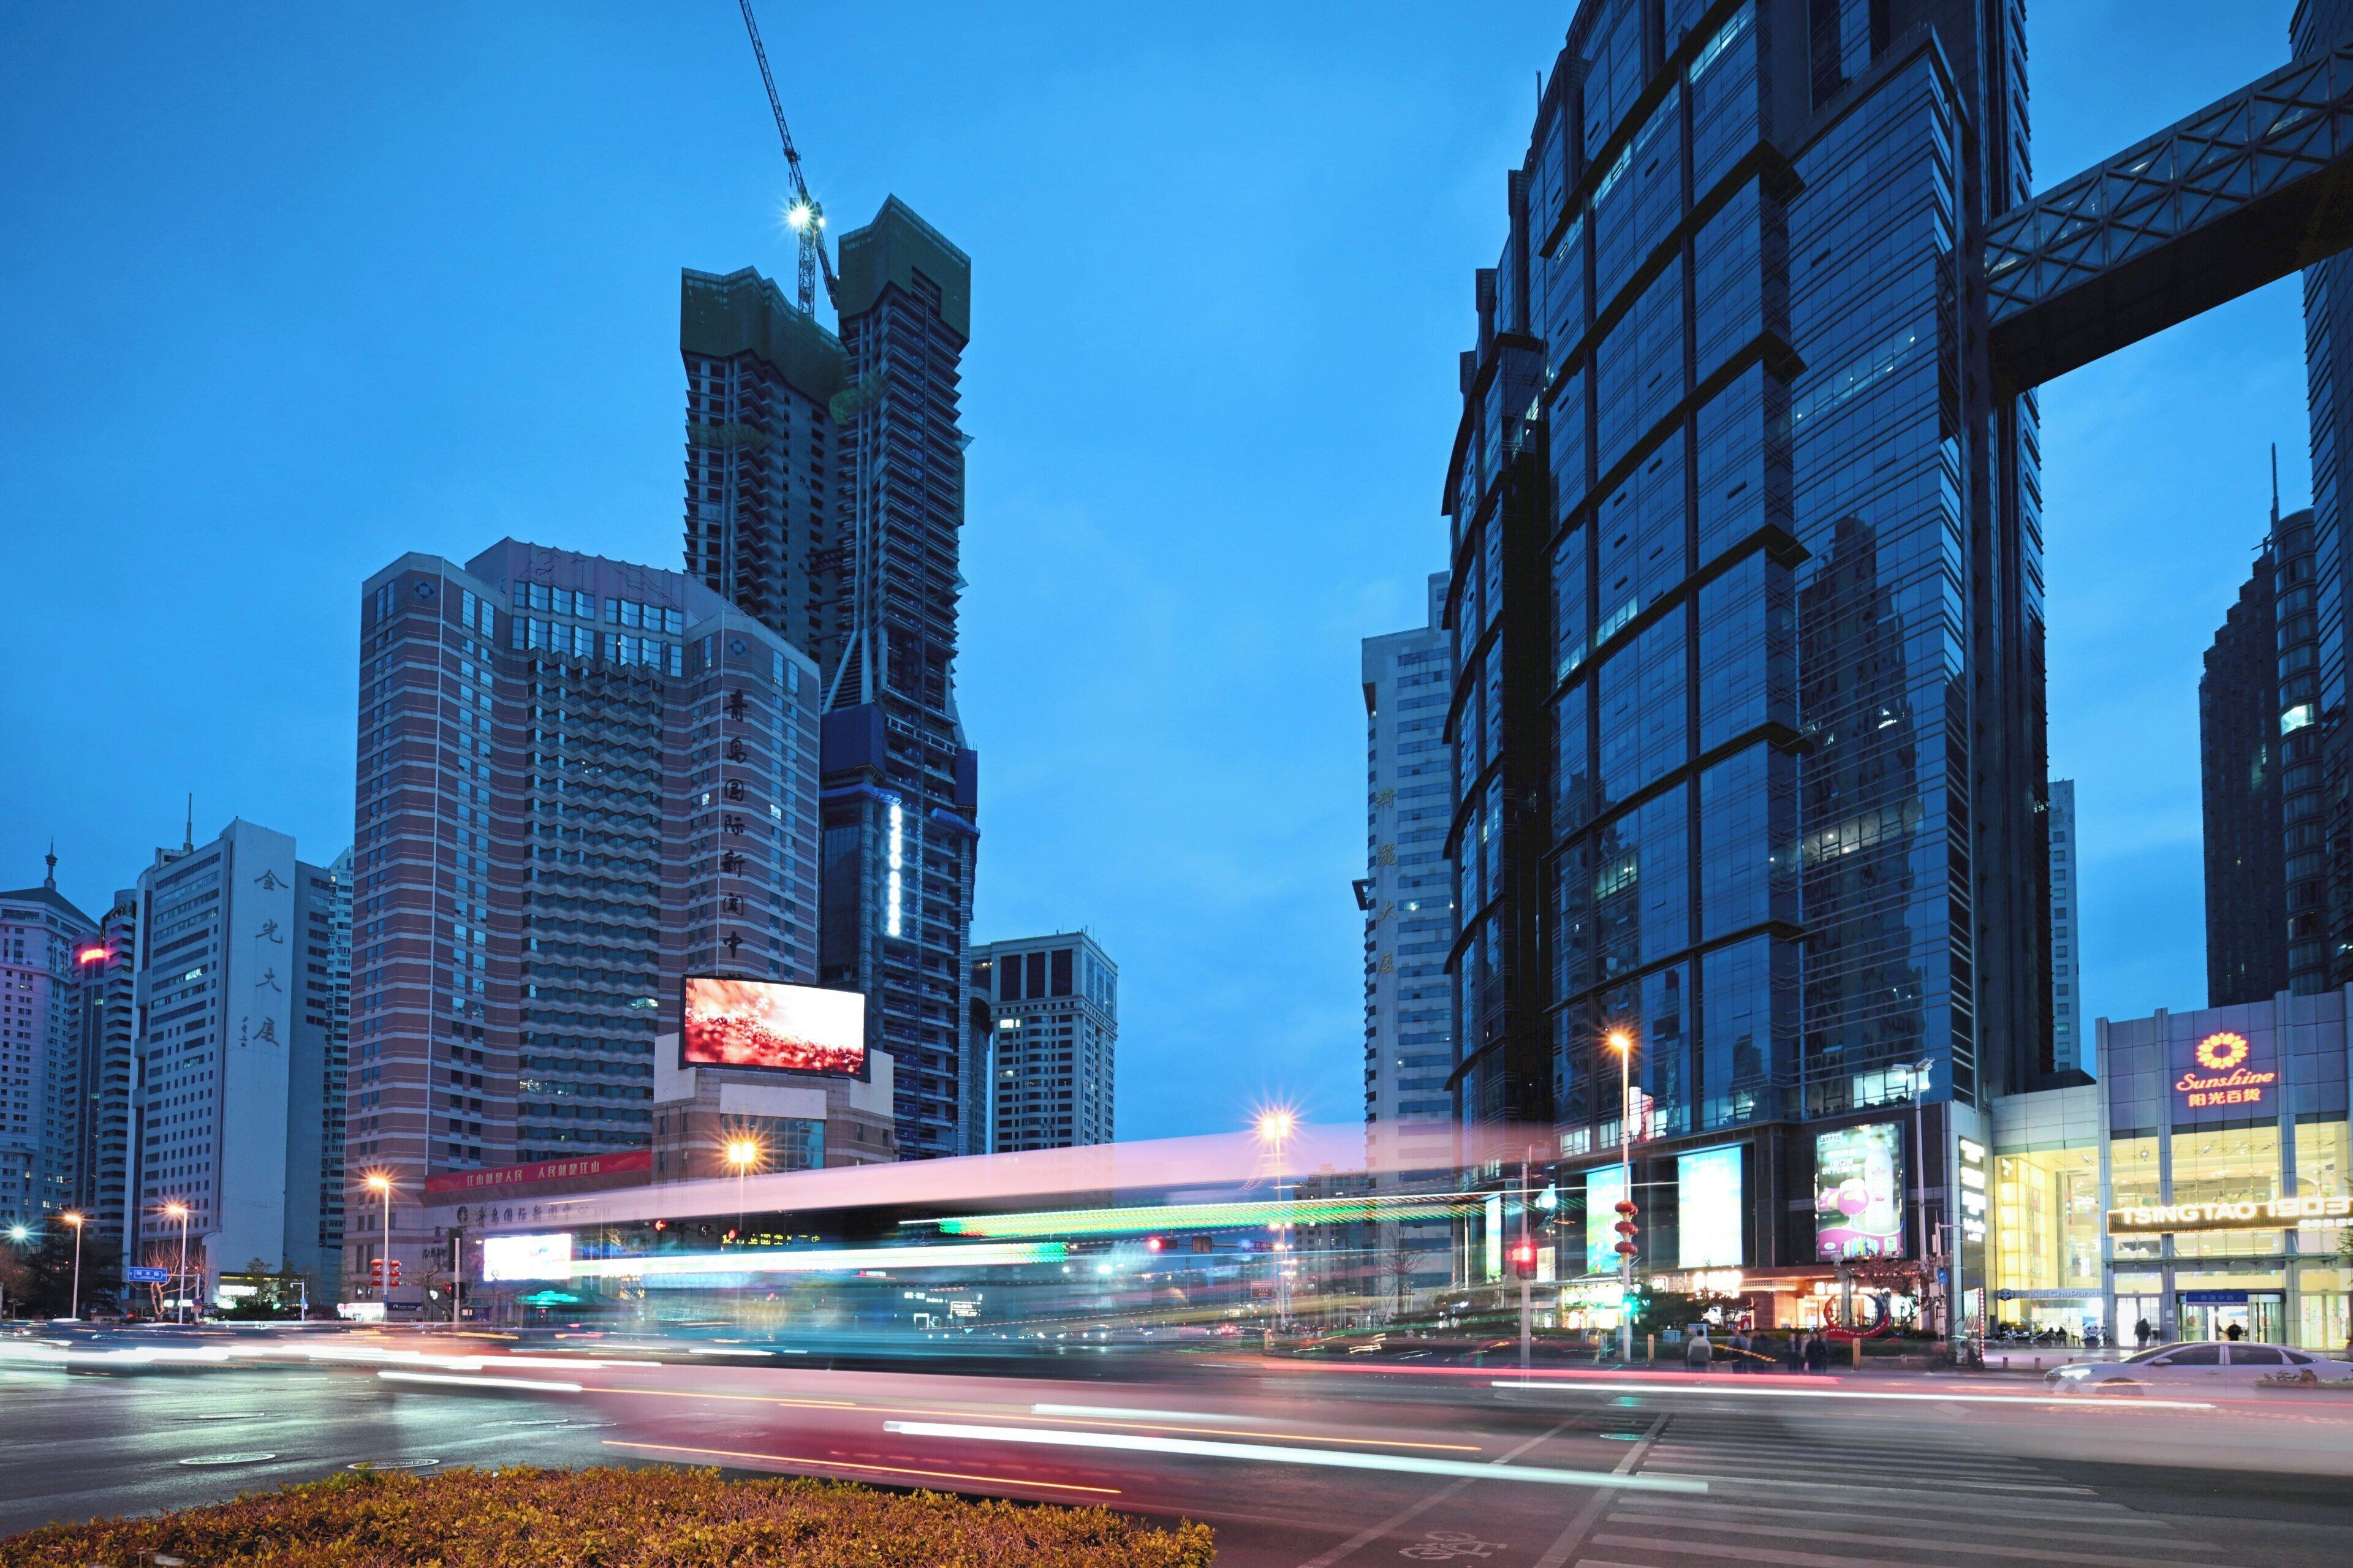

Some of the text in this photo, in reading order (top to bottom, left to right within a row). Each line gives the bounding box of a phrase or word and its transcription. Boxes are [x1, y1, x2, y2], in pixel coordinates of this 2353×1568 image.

[722, 689, 748, 978] 青岛国际新闻中
[2175, 1068, 2275, 1091] Sunshine
[2188, 1088, 2261, 1108] 阳光百货
[466, 1161, 600, 1187] 江山就是人民 人民就是江山
[2122, 1195, 2350, 1224] TSINGTAO 1903
